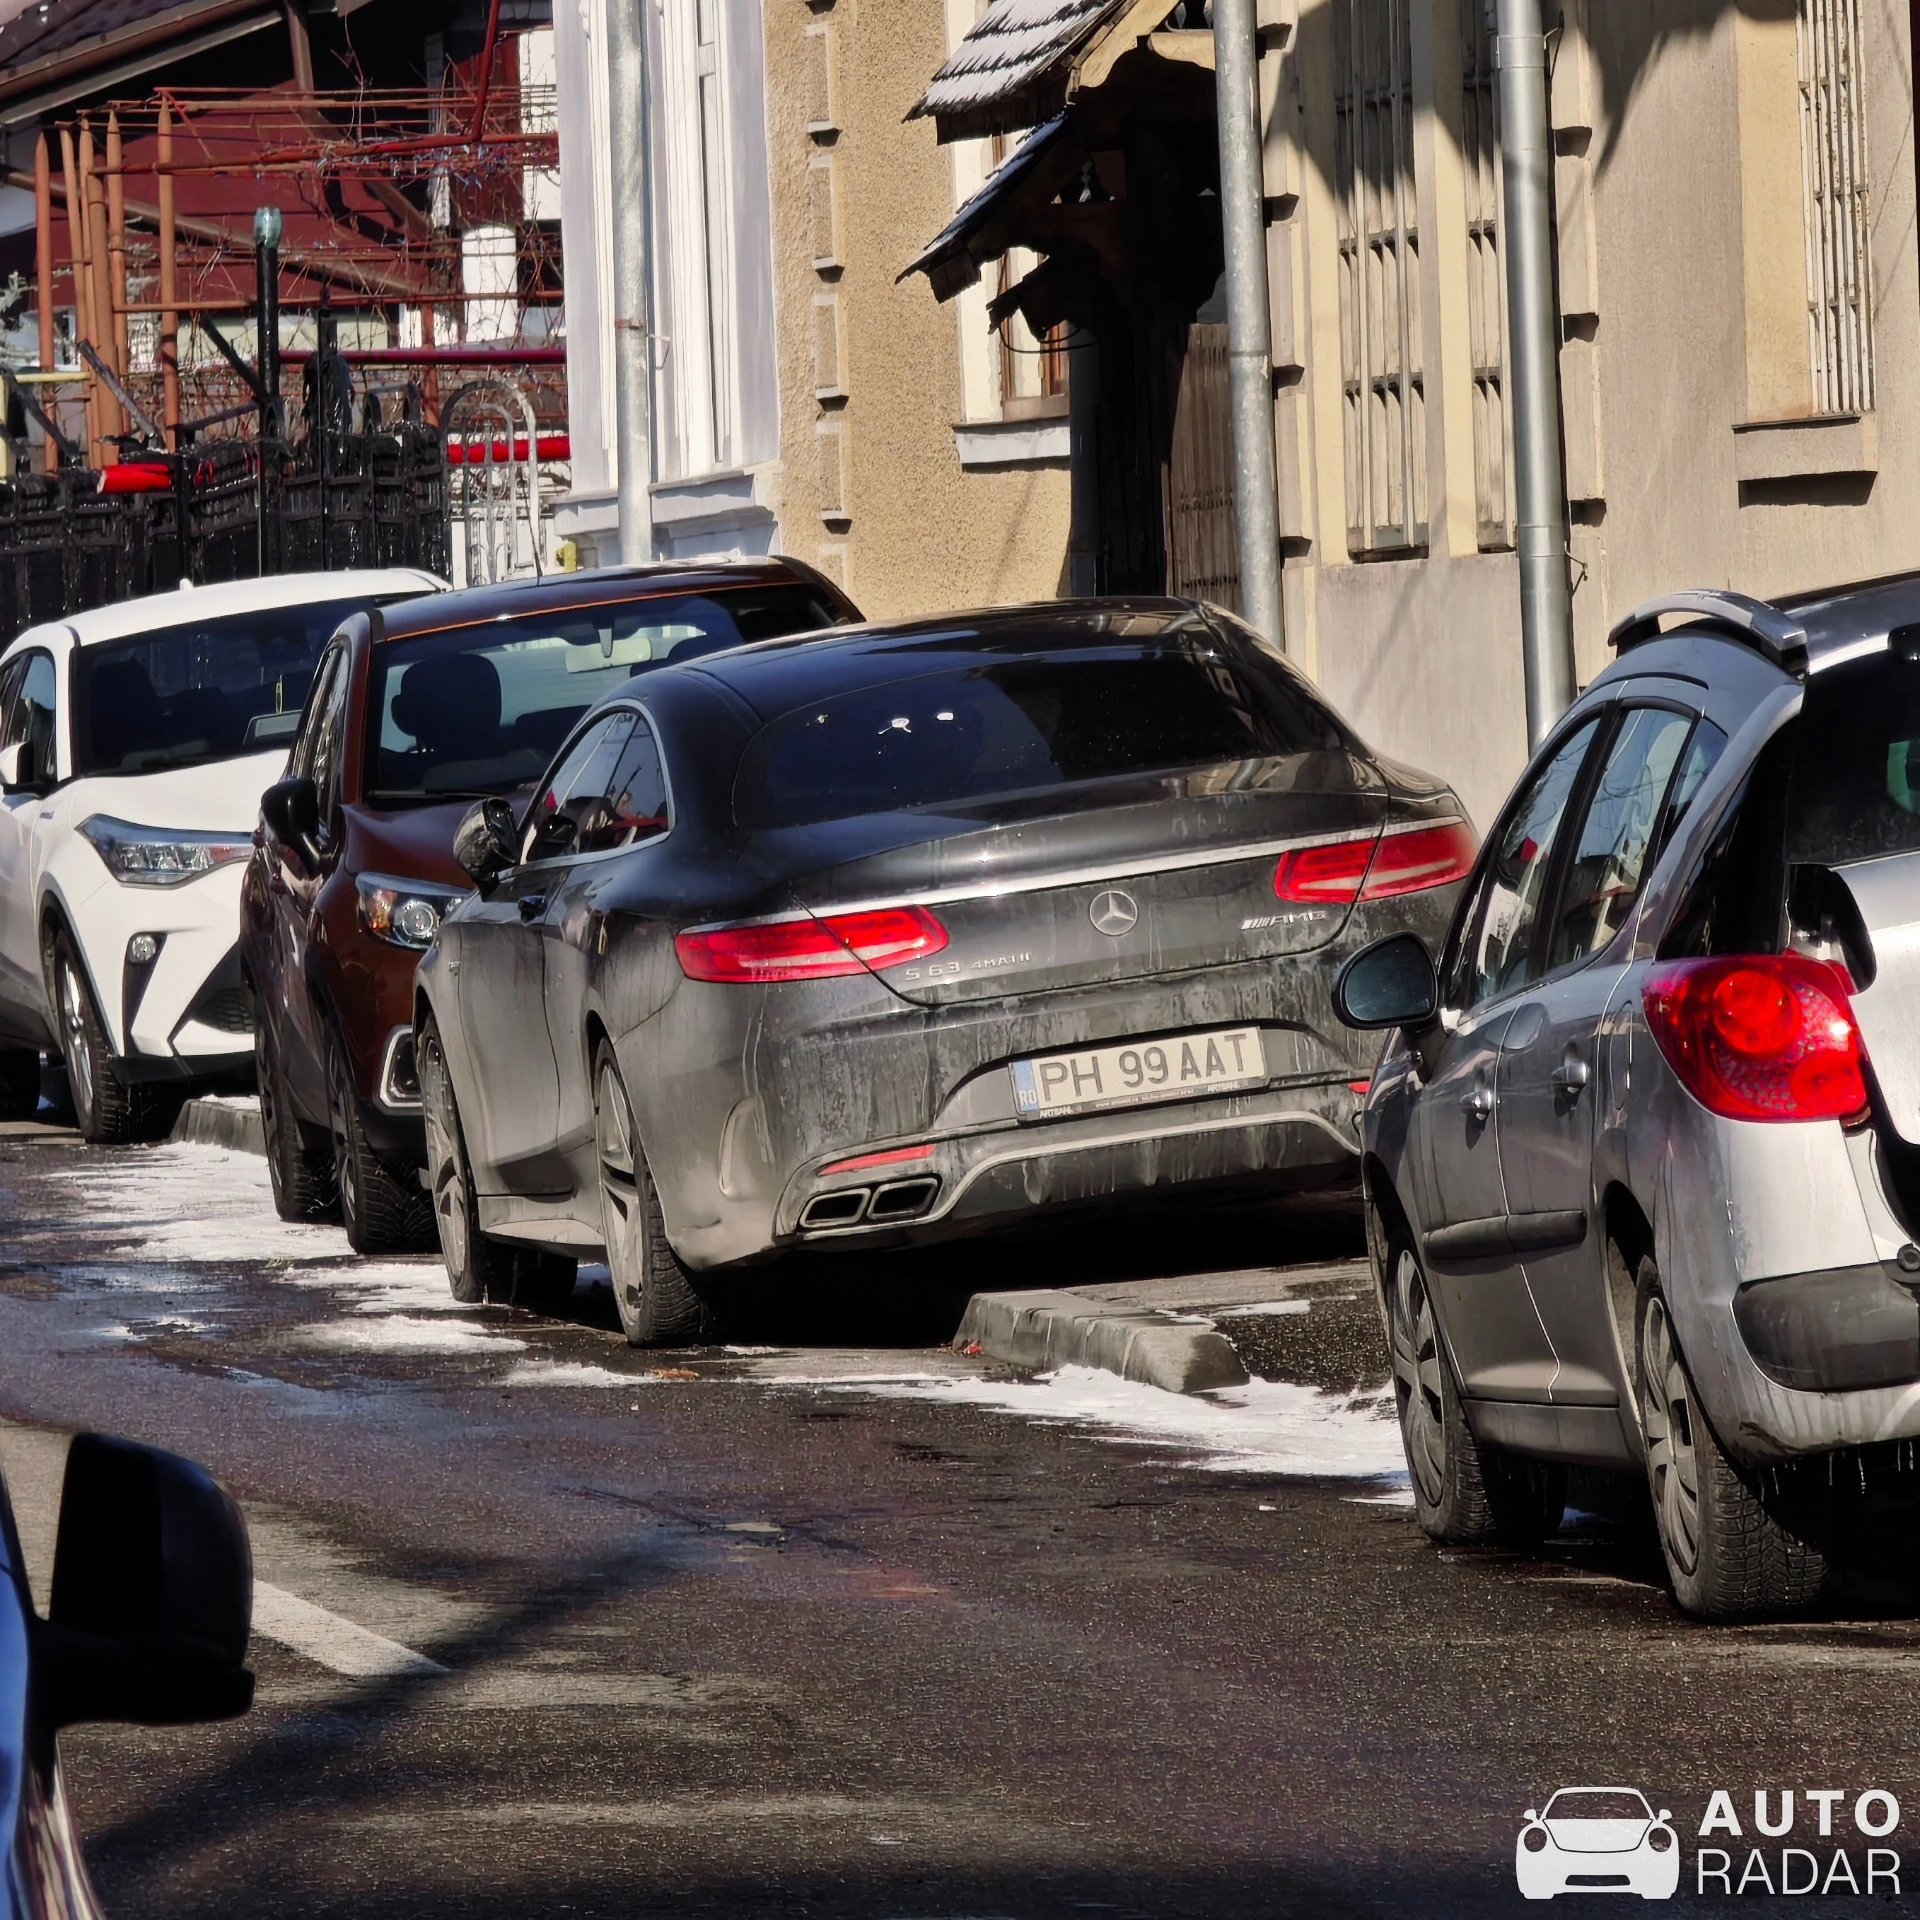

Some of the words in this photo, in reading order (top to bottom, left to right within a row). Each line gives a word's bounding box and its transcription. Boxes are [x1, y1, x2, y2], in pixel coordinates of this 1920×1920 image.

[1269, 910, 1328, 927] AMG
[905, 967, 920, 981] S
[928, 961, 960, 977] 63
[1018, 1089, 1037, 1107] RO
[1039, 1055, 1103, 1102] PH
[1118, 1046, 1169, 1088] 99
[1180, 1033, 1247, 1081] AAT
